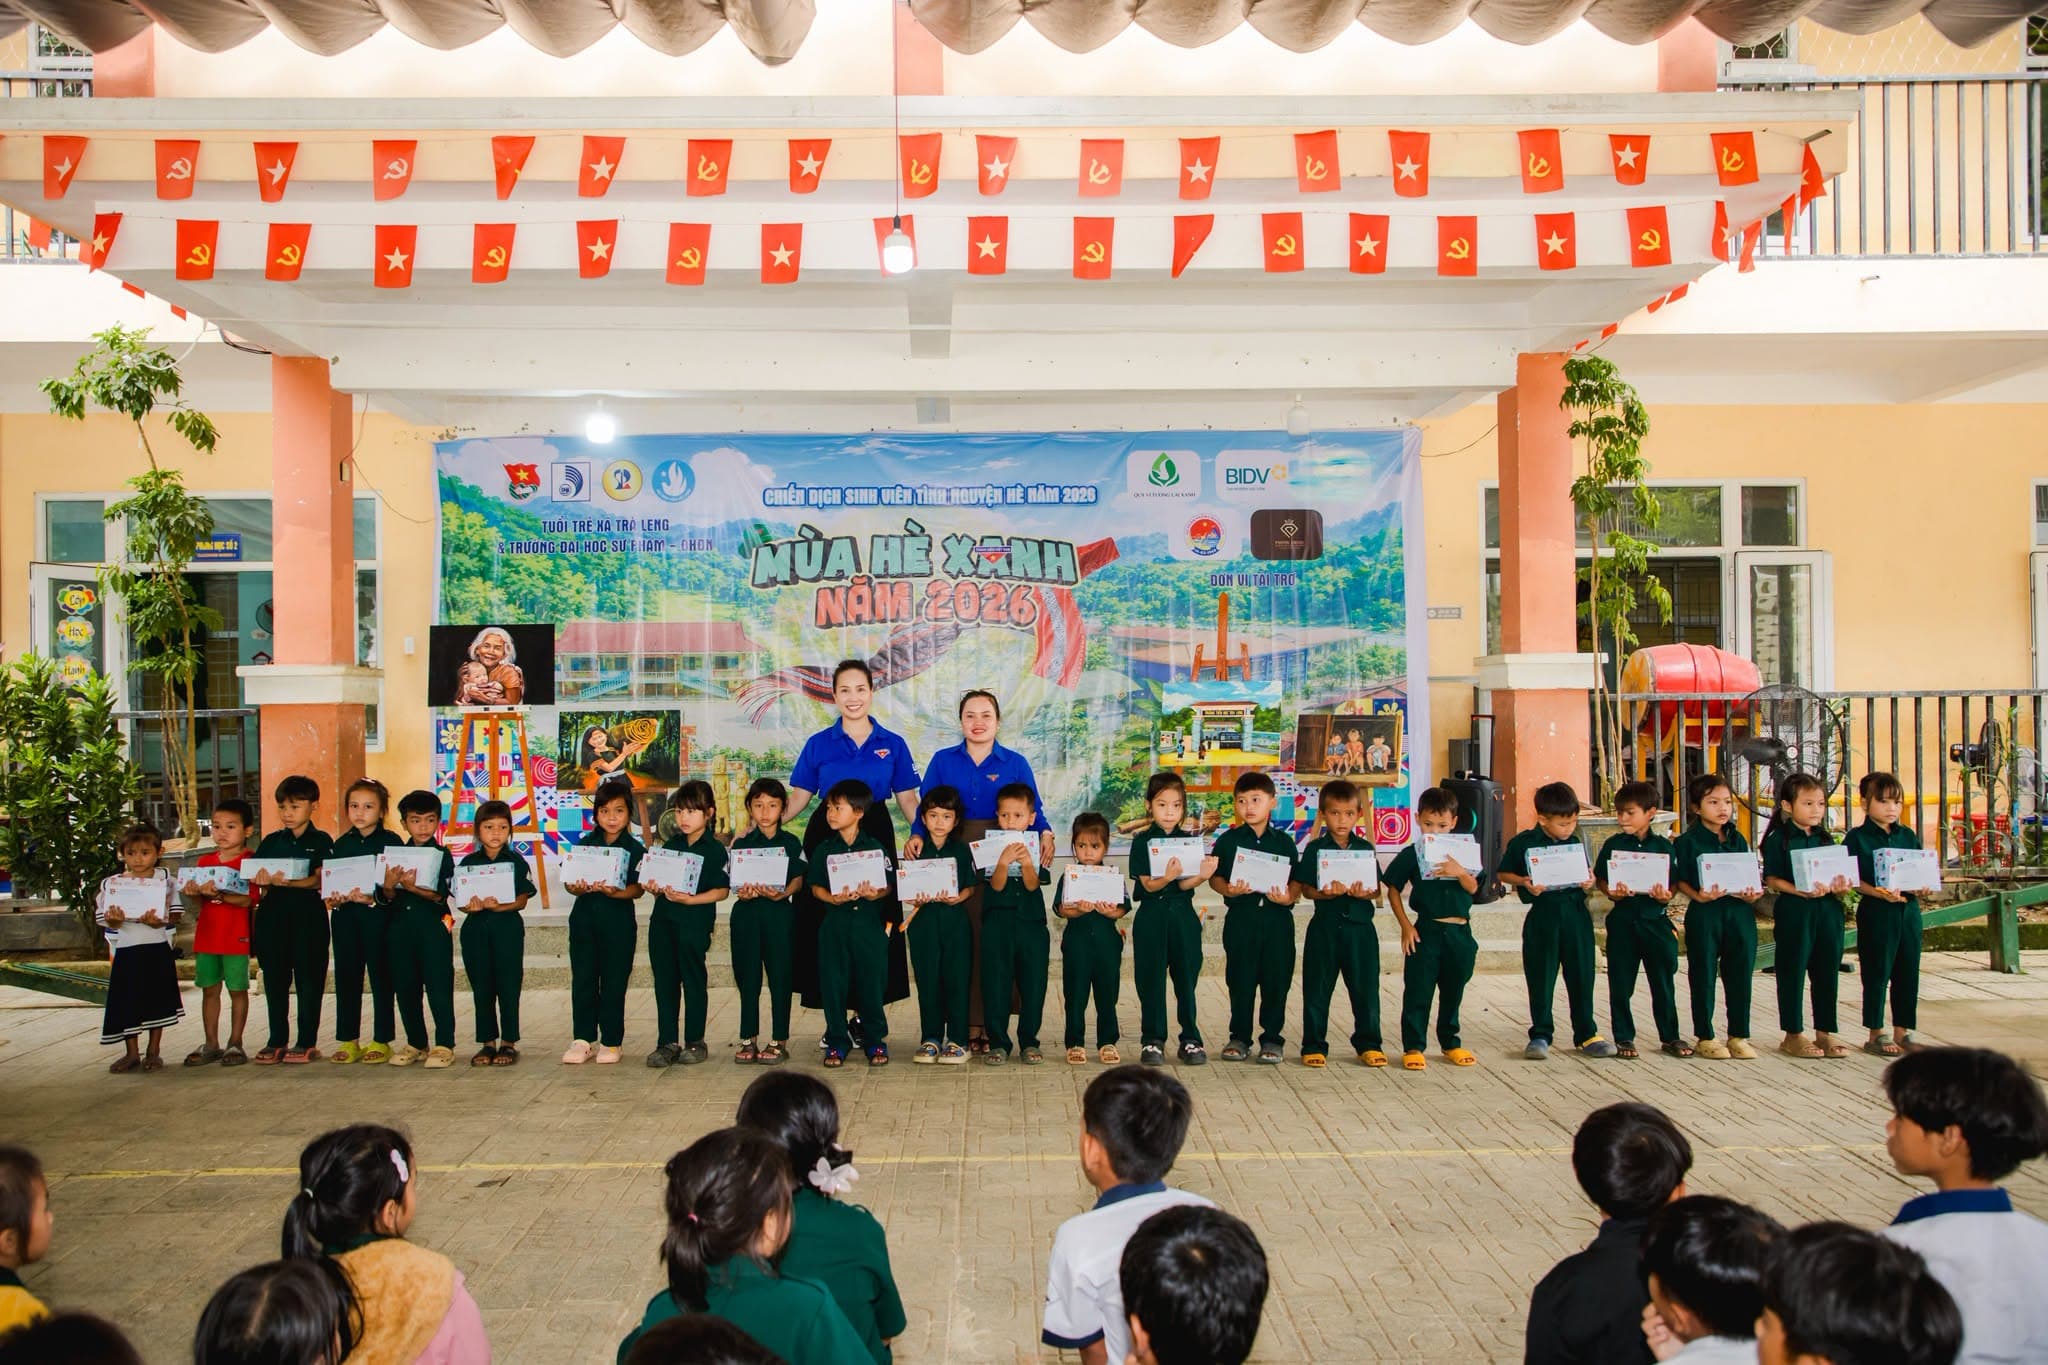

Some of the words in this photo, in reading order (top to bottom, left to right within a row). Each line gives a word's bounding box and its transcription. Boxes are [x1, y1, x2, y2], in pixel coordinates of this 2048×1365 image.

[1226, 467, 1271, 485] BIDV
[763, 482, 806, 506] CHIẾN
[807, 487, 843, 509] DỊCH
[844, 486, 879, 505] SINH
[880, 484, 913, 505] VIÊN
[915, 484, 948, 505] TÌNH
[949, 483, 1003, 508] NGUYỆN
[1005, 483, 1025, 505] HÈ
[1026, 483, 1061, 505] NĂM
[542, 516, 568, 533] TUỔI
[641, 519, 669, 531] LENG
[498, 542, 504, 553] &
[509, 539, 555, 553] TRƯỜNG
[612, 539, 626, 552] SƯ
[751, 523, 862, 587] MÙA
[869, 518, 933, 579] HÈ
[942, 533, 1078, 585] XANH
[1210, 573, 1233, 586] ĐƠN
[814, 574, 914, 629] NĂM
[923, 578, 1038, 626] 2026
